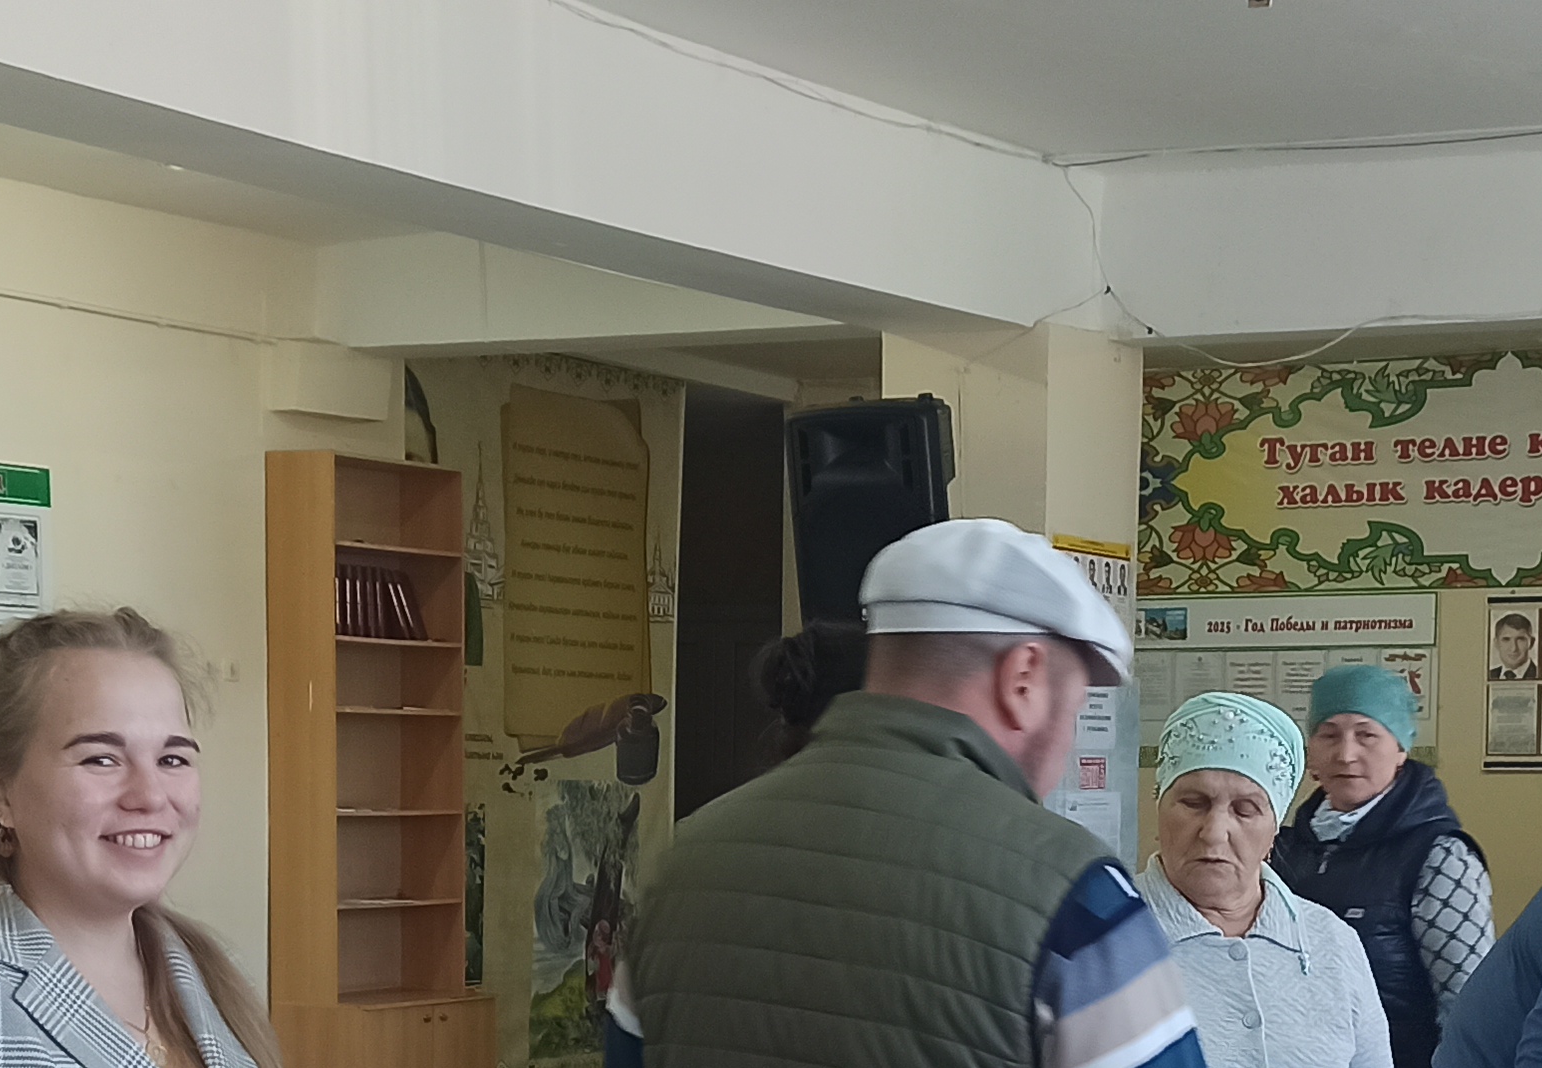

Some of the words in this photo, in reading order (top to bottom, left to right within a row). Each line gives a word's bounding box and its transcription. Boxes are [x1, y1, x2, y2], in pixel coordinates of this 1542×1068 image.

[1259, 436, 1376, 474] Туган
[1393, 433, 1509, 462] телне
[1276, 480, 1407, 508] халык
[1206, 620, 1232, 634] 2025
[1244, 618, 1265, 633] Год
[1270, 615, 1316, 632] Победы
[1321, 619, 1329, 631] и
[1334, 618, 1414, 633] патриотизма
